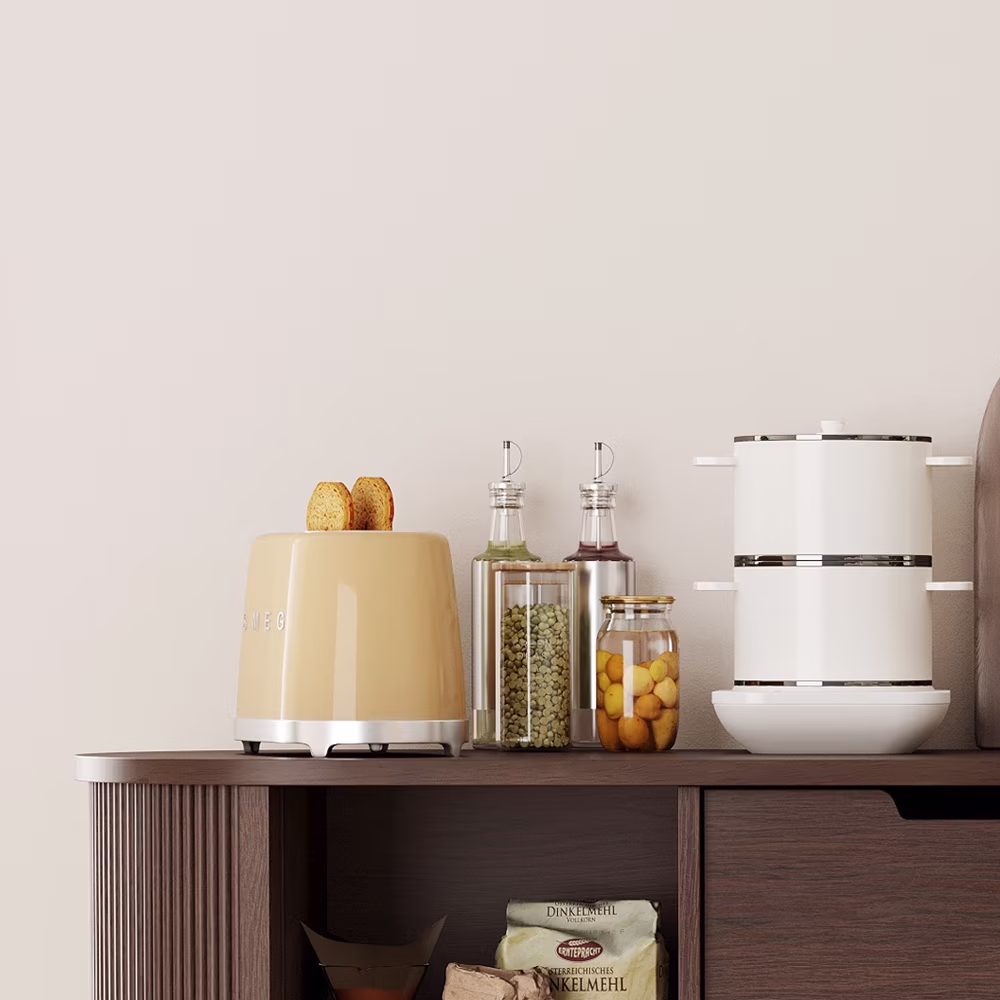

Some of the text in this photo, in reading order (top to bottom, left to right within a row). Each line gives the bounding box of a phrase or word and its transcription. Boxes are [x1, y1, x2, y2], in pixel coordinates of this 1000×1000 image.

[547, 906, 617, 917] DINKELMEHL
[557, 946, 602, 958] ERNTEPRACHT
[548, 966, 614, 976] STERREICHISCHES
[550, 977, 627, 992] NKELMEHL
